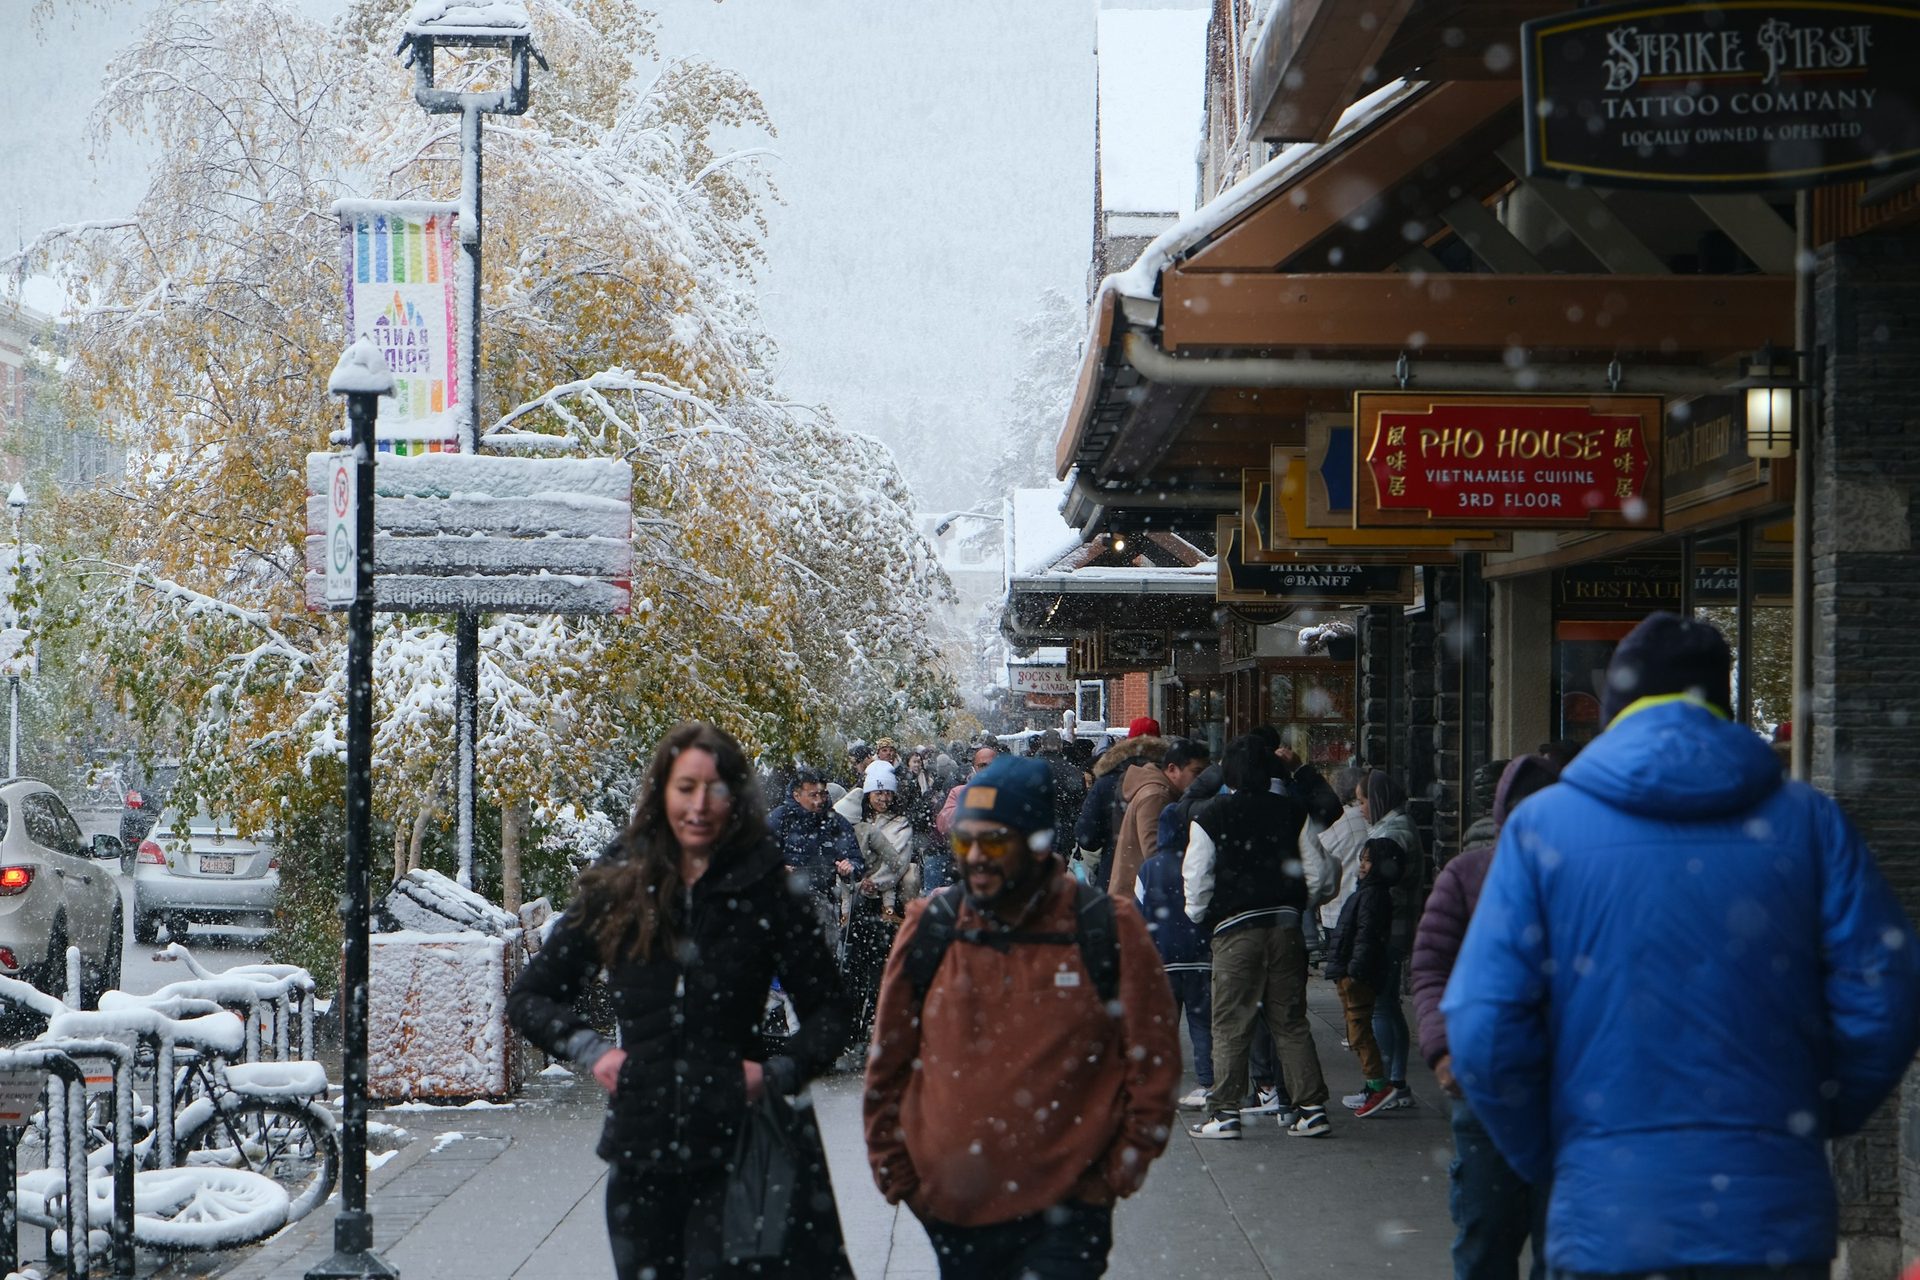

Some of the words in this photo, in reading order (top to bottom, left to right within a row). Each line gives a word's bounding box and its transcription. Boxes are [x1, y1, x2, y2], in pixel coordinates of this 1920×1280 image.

[1602, 25, 1745, 91] STRIKE
[1757, 17, 1874, 85] FIRST
[1601, 93, 1719, 119] TATTOO
[1730, 88, 1877, 114] COMPANY
[1621, 128, 1691, 147] LOCALLY
[1695, 126, 1758, 144] OWNED
[1762, 126, 1774, 141] &
[1780, 122, 1862, 140] OPERATED
[1420, 428, 1485, 459] PHO
[1496, 428, 1605, 460] HOUSE
[1386, 425, 1407, 497] 風味居
[1425, 469, 1526, 484] VIETNAMESE
[1534, 470, 1595, 484] CUISINE
[1458, 493, 1494, 508] 3RD
[1504, 492, 1563, 508] FLOOR
[1283, 575, 1352, 587] @BANFF
[463, 587, 551, 605] Mountain
